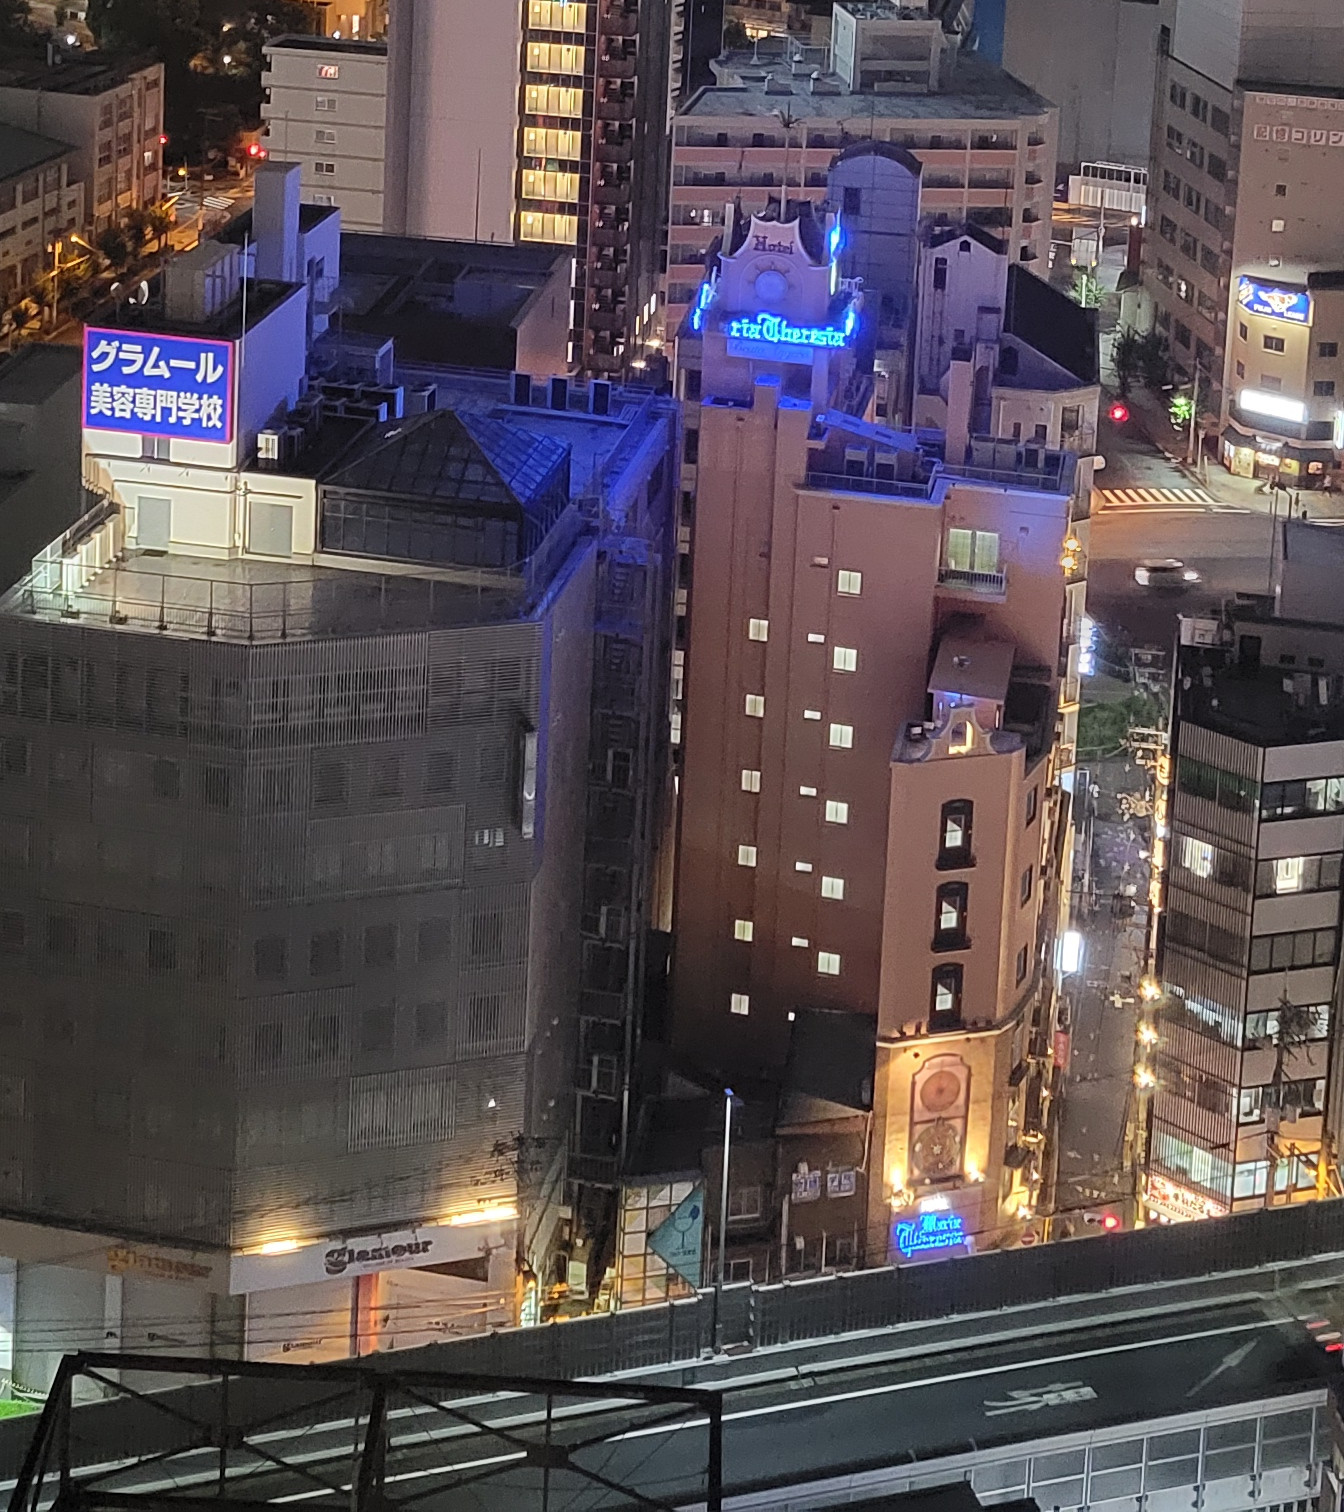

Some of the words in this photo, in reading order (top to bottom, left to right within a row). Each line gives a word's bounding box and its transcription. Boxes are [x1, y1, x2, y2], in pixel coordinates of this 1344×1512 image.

[91, 340, 224, 384] グラムール
[90, 382, 223, 429] 美容専門学校
